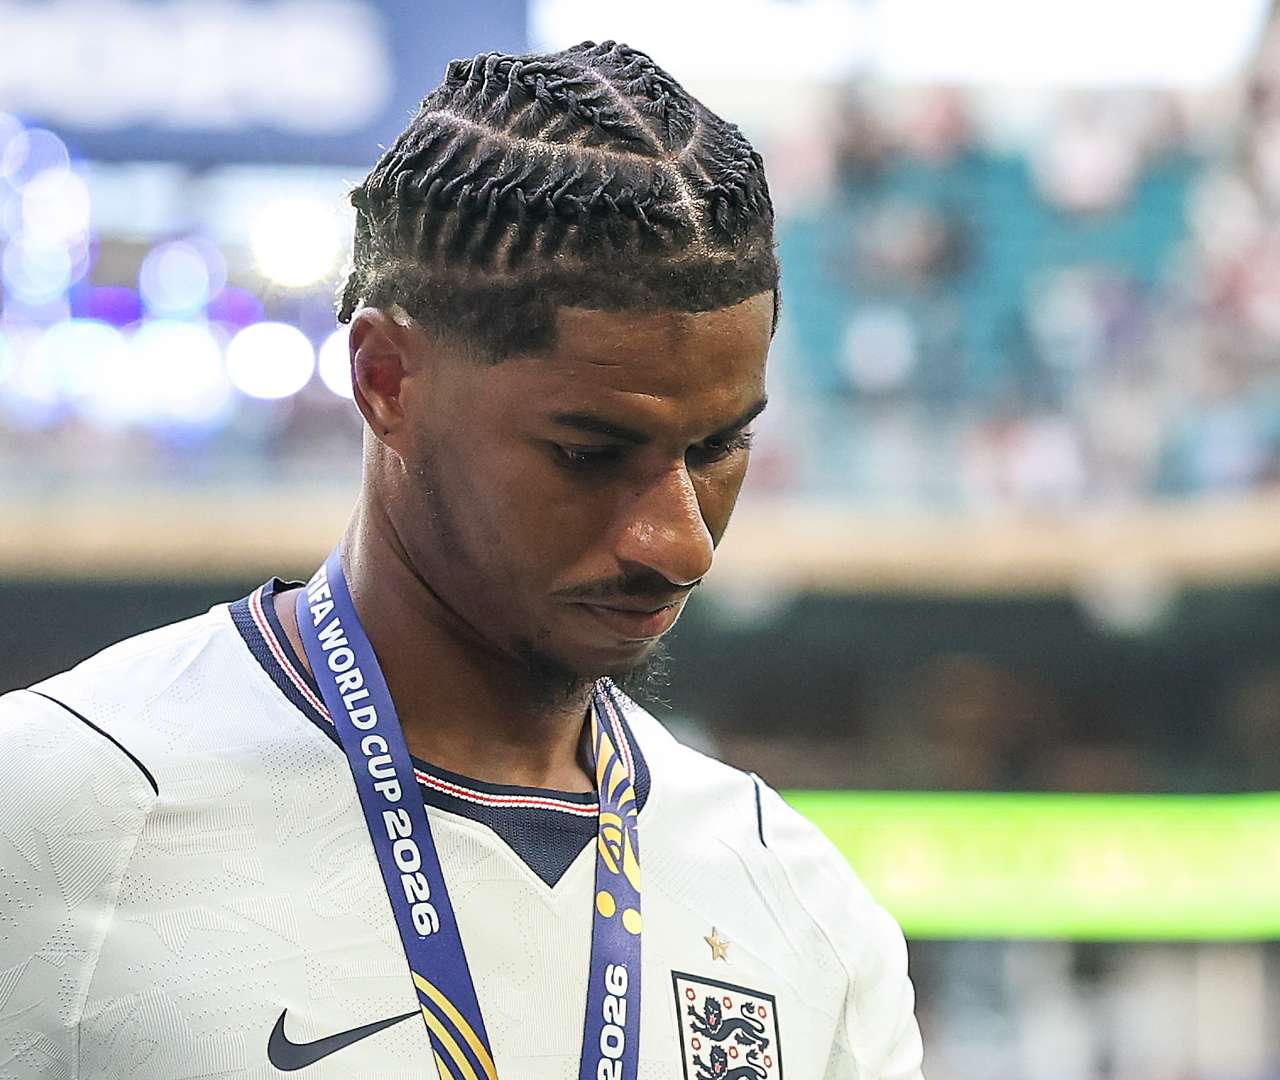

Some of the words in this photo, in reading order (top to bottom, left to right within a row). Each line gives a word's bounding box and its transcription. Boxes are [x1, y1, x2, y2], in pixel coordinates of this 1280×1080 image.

[317, 616, 378, 731] WORLD
[360, 733, 403, 804] CUP
[381, 807, 441, 937] 2026
